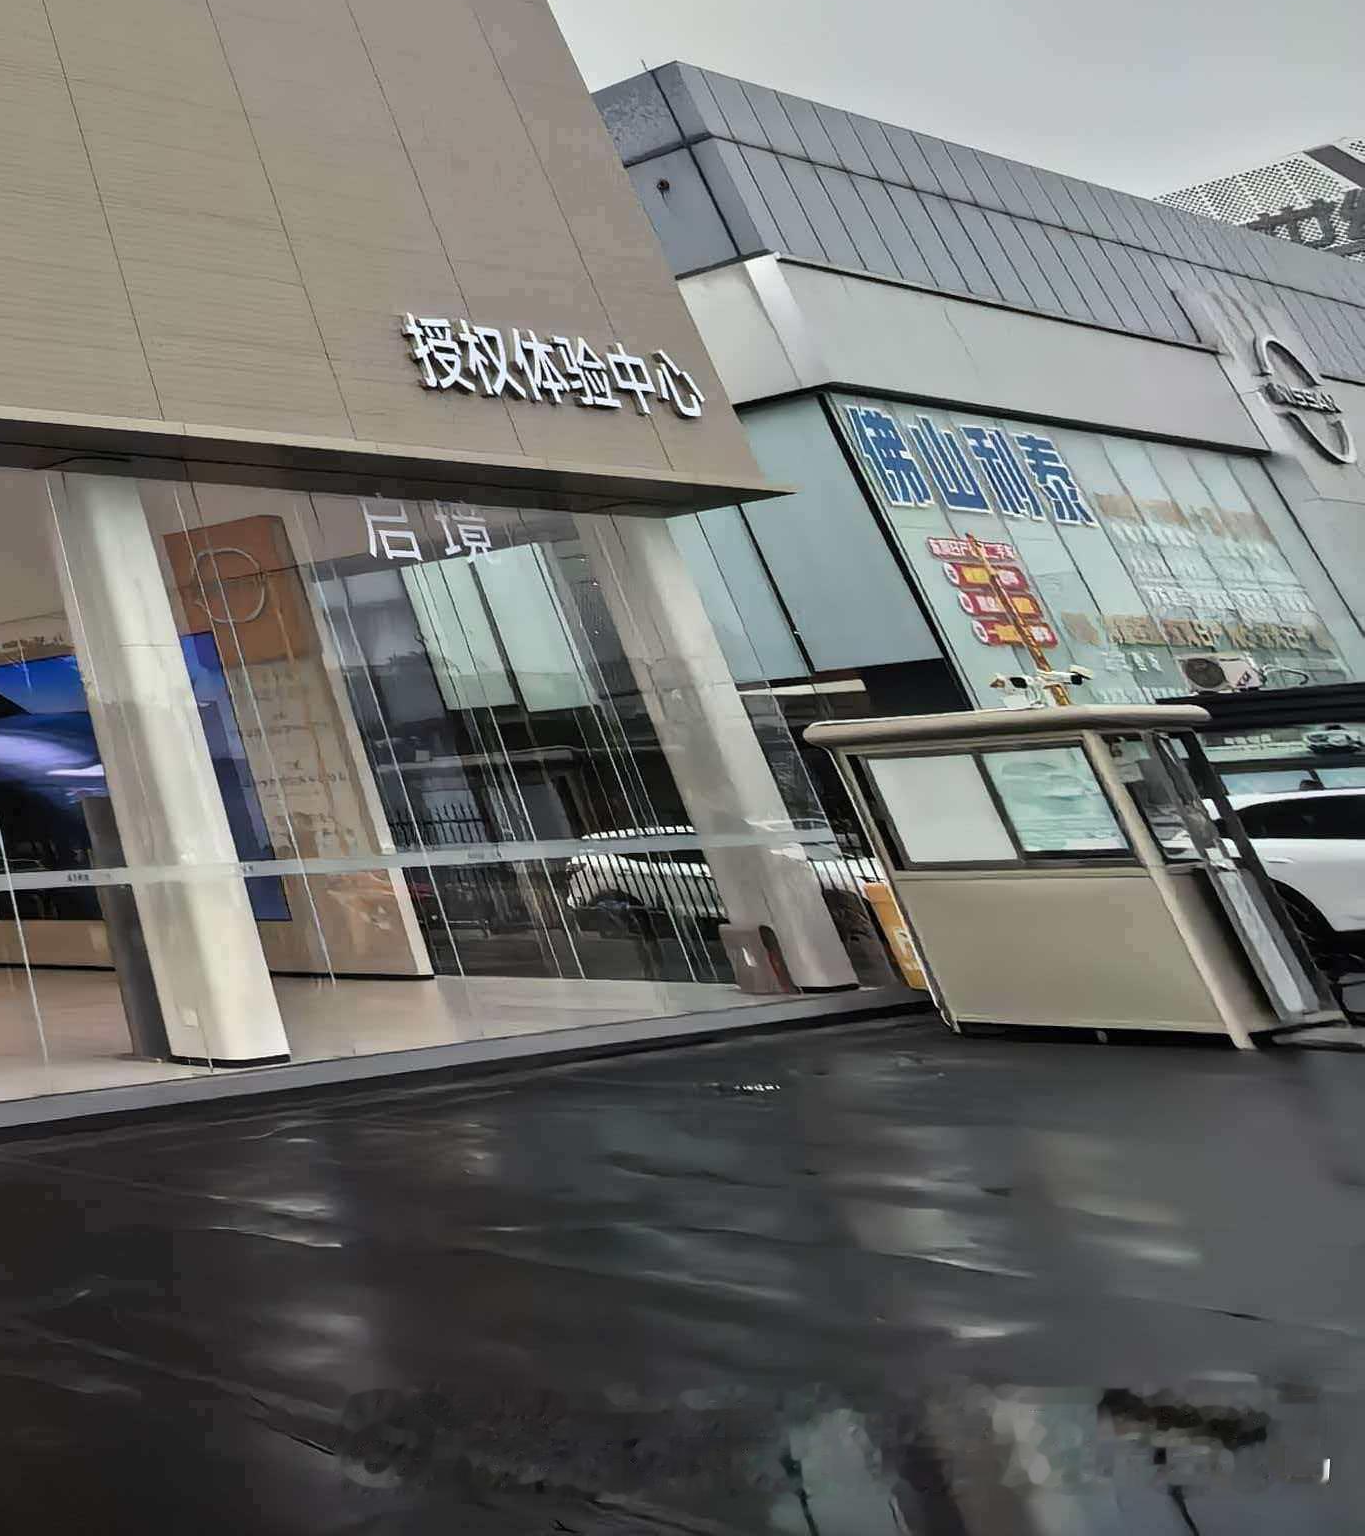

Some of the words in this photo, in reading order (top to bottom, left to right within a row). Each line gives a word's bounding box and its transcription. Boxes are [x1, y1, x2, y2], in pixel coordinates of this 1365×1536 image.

[401, 312, 706, 419] 授权体验中心
[1265, 382, 1342, 414] NISSAN
[846, 404, 1100, 528] 佛山利泰
